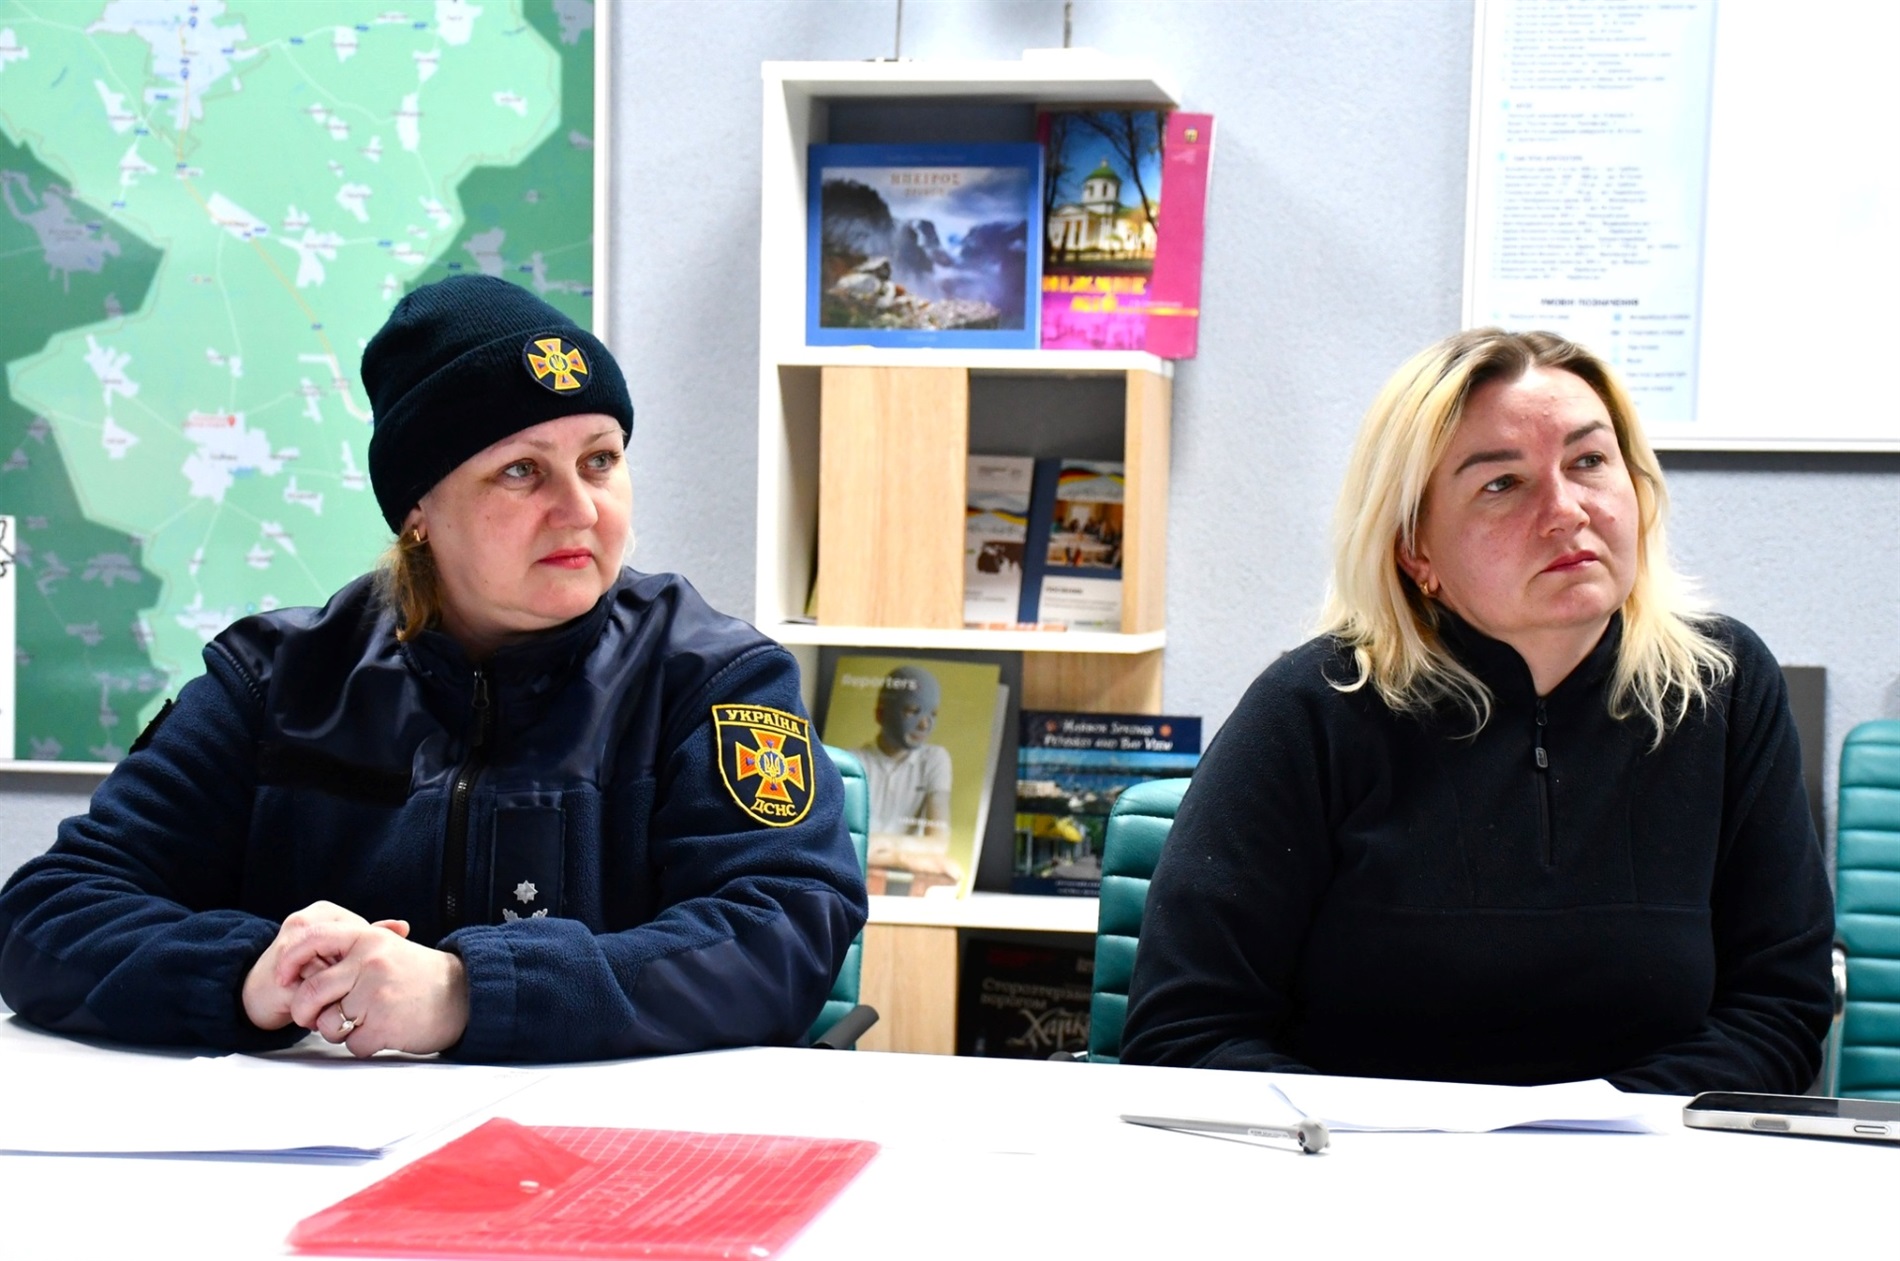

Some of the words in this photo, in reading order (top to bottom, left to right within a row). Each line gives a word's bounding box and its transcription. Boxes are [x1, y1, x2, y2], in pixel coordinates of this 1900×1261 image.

[841, 673, 918, 692] Reporters
[725, 709, 800, 733] УКРАЇНА
[751, 798, 797, 816] ДСНС
